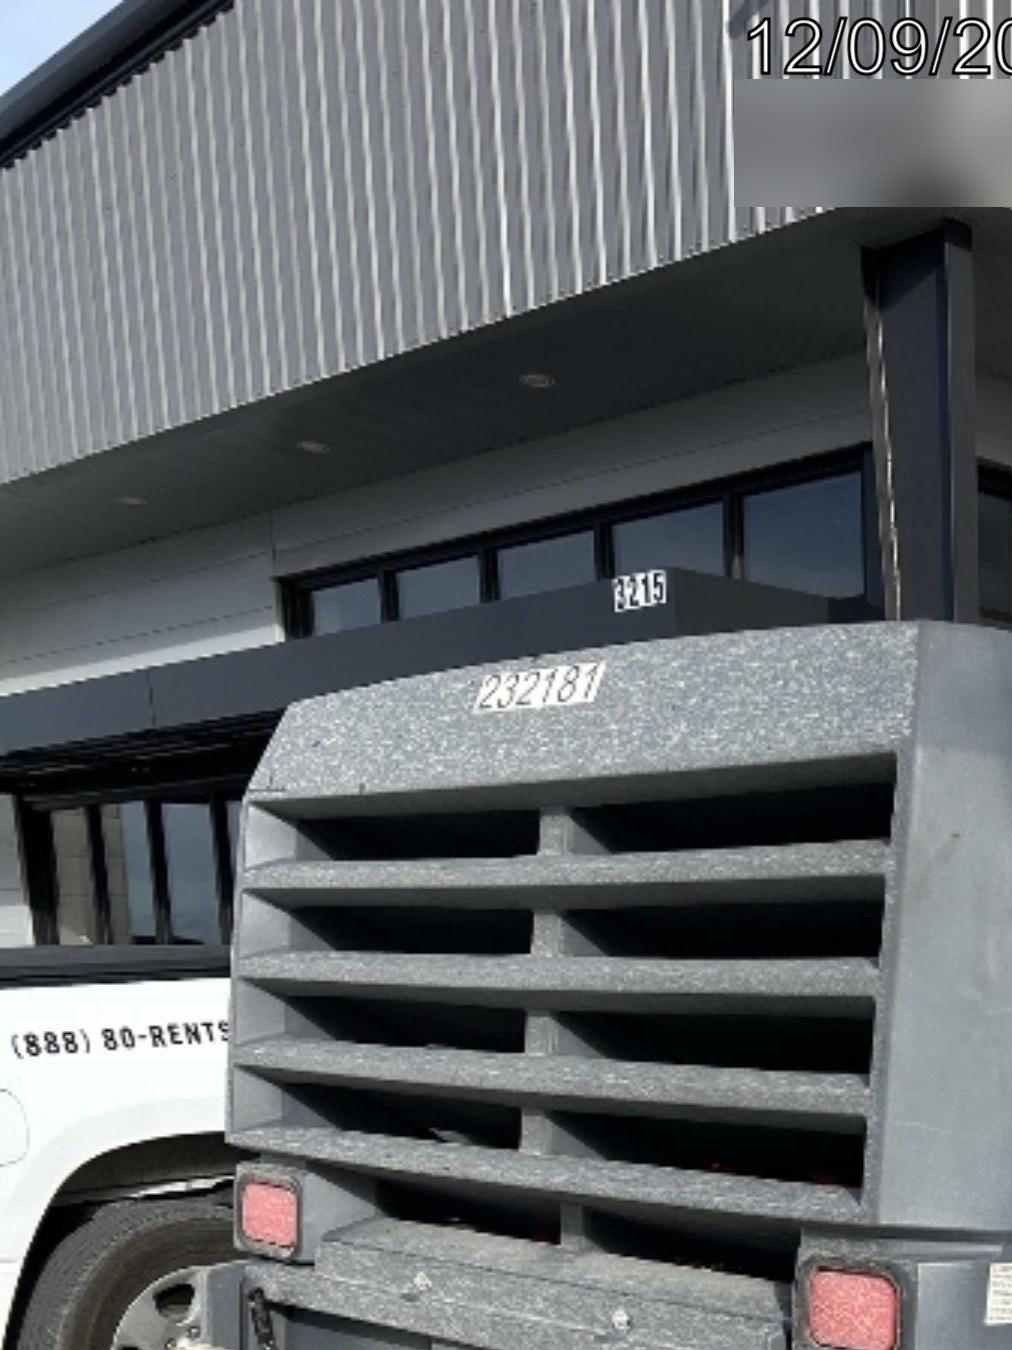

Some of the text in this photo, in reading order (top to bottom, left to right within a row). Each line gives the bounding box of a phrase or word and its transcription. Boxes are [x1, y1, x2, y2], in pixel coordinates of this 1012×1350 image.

[614, 569, 666, 612] 3215
[476, 662, 602, 711] 232181
[11, 1018, 229, 1060] (888) 80-RENTS
